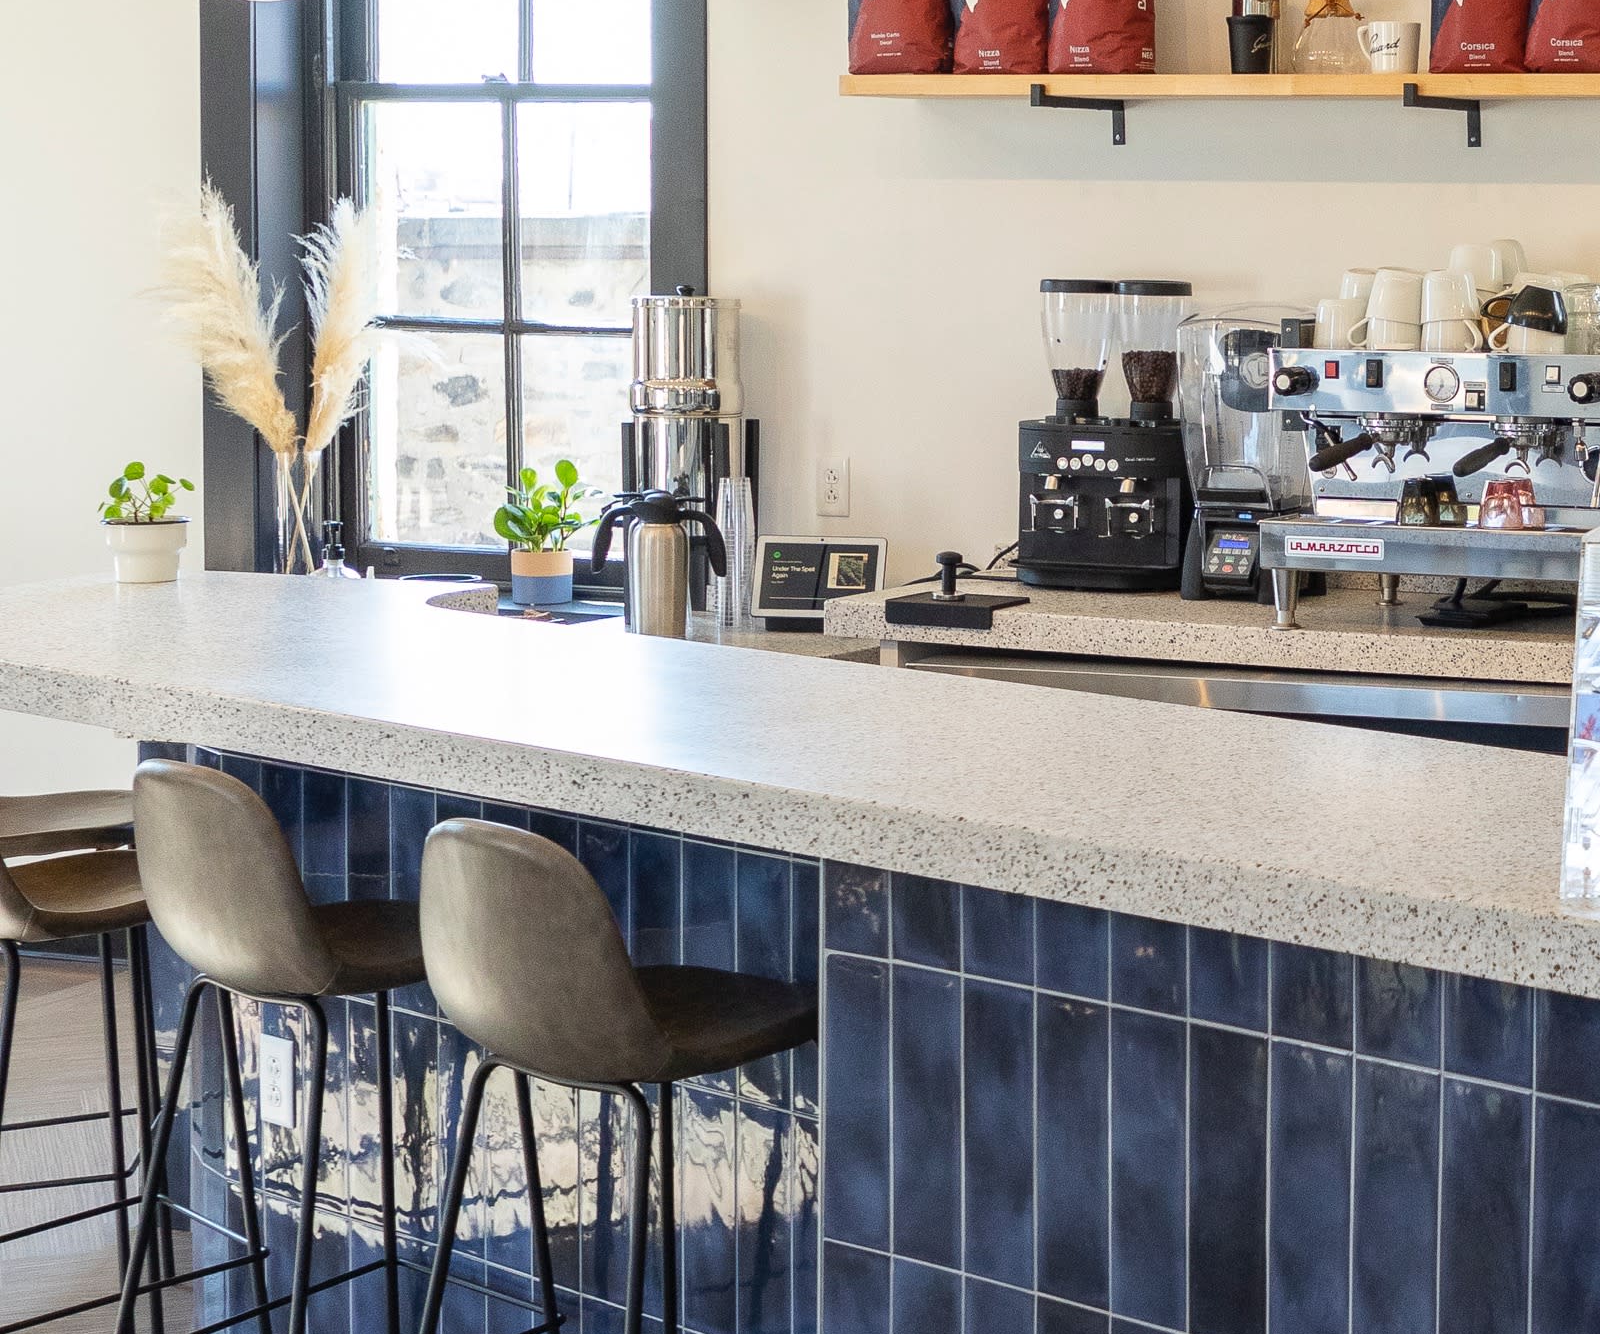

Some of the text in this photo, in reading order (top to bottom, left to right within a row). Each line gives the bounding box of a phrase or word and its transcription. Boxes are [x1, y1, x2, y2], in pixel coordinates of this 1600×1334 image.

[1460, 42, 1495, 51] Corsica
[1550, 38, 1583, 47] Corsica
[771, 572, 789, 580] Again
